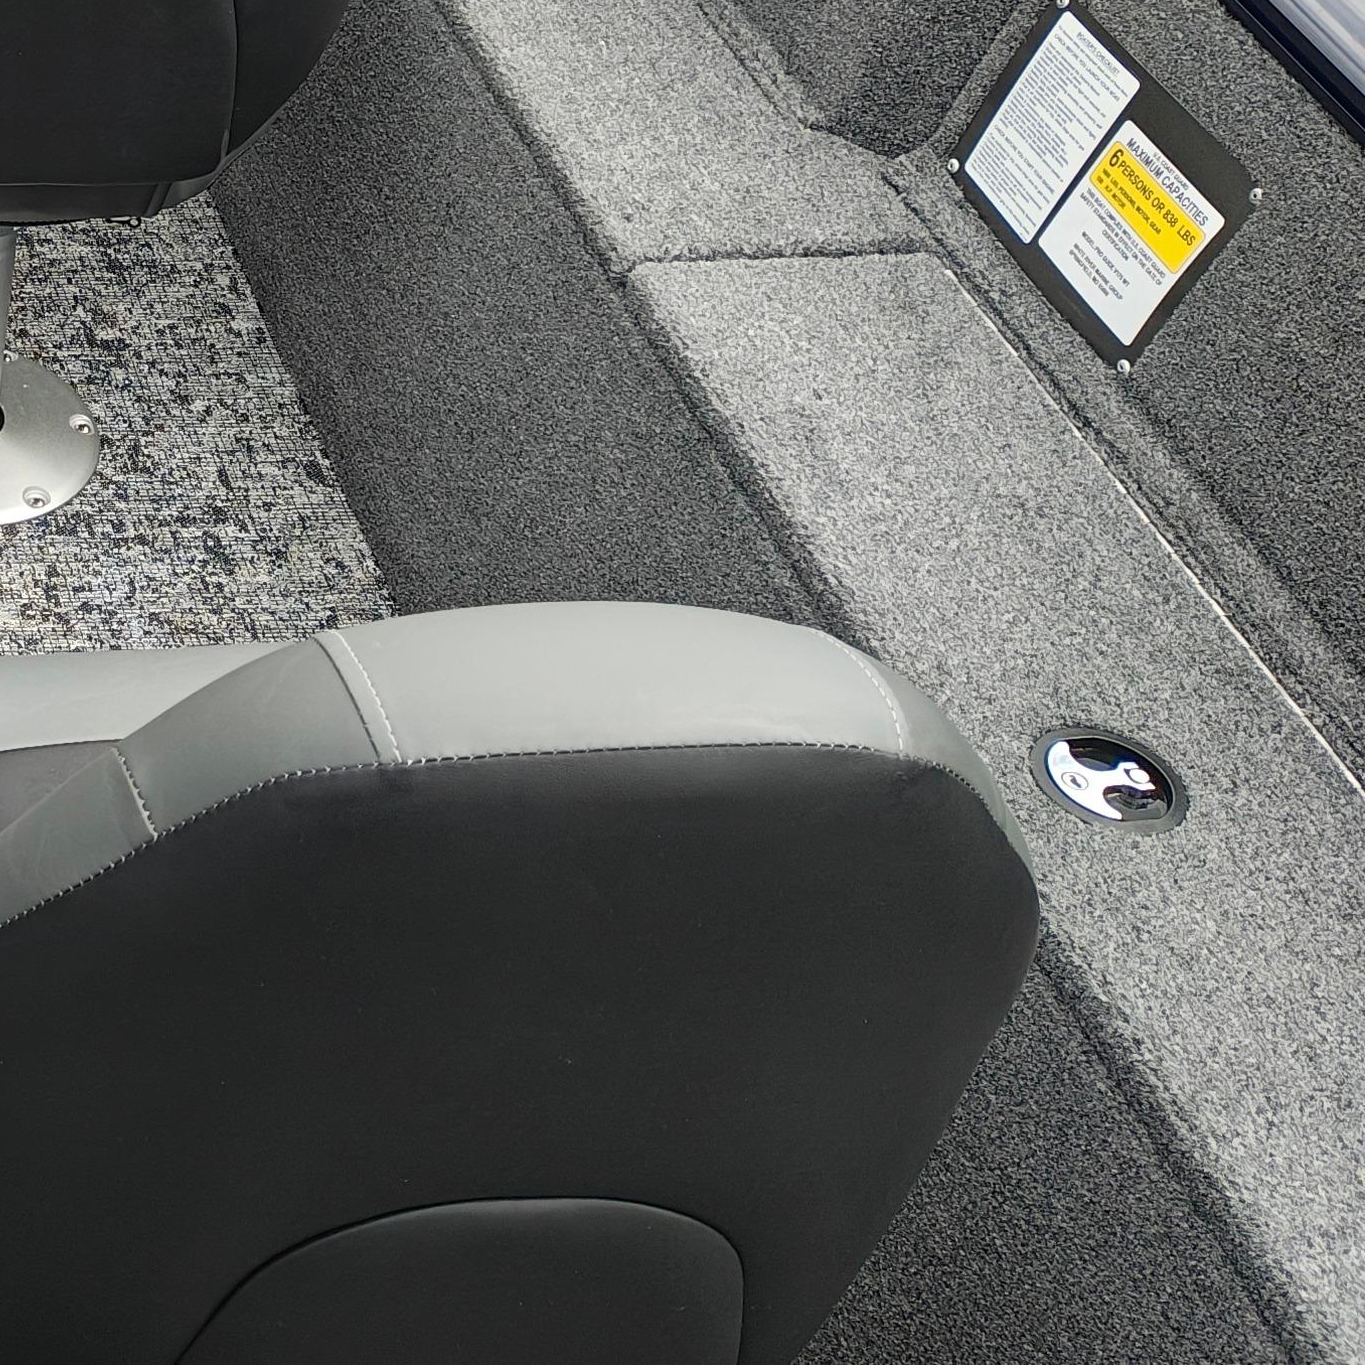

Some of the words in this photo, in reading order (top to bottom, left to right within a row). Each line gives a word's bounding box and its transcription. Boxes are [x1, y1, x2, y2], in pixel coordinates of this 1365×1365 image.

[1109, 149, 1124, 167] 6
[1116, 159, 1154, 201] PERSONS
[1125, 137, 1165, 179] MAXIMUM
[1160, 174, 1209, 227] CAPACITIES
[1149, 195, 1166, 214] OR
[1161, 208, 1179, 228] 838
[1176, 224, 1196, 247] LBS
